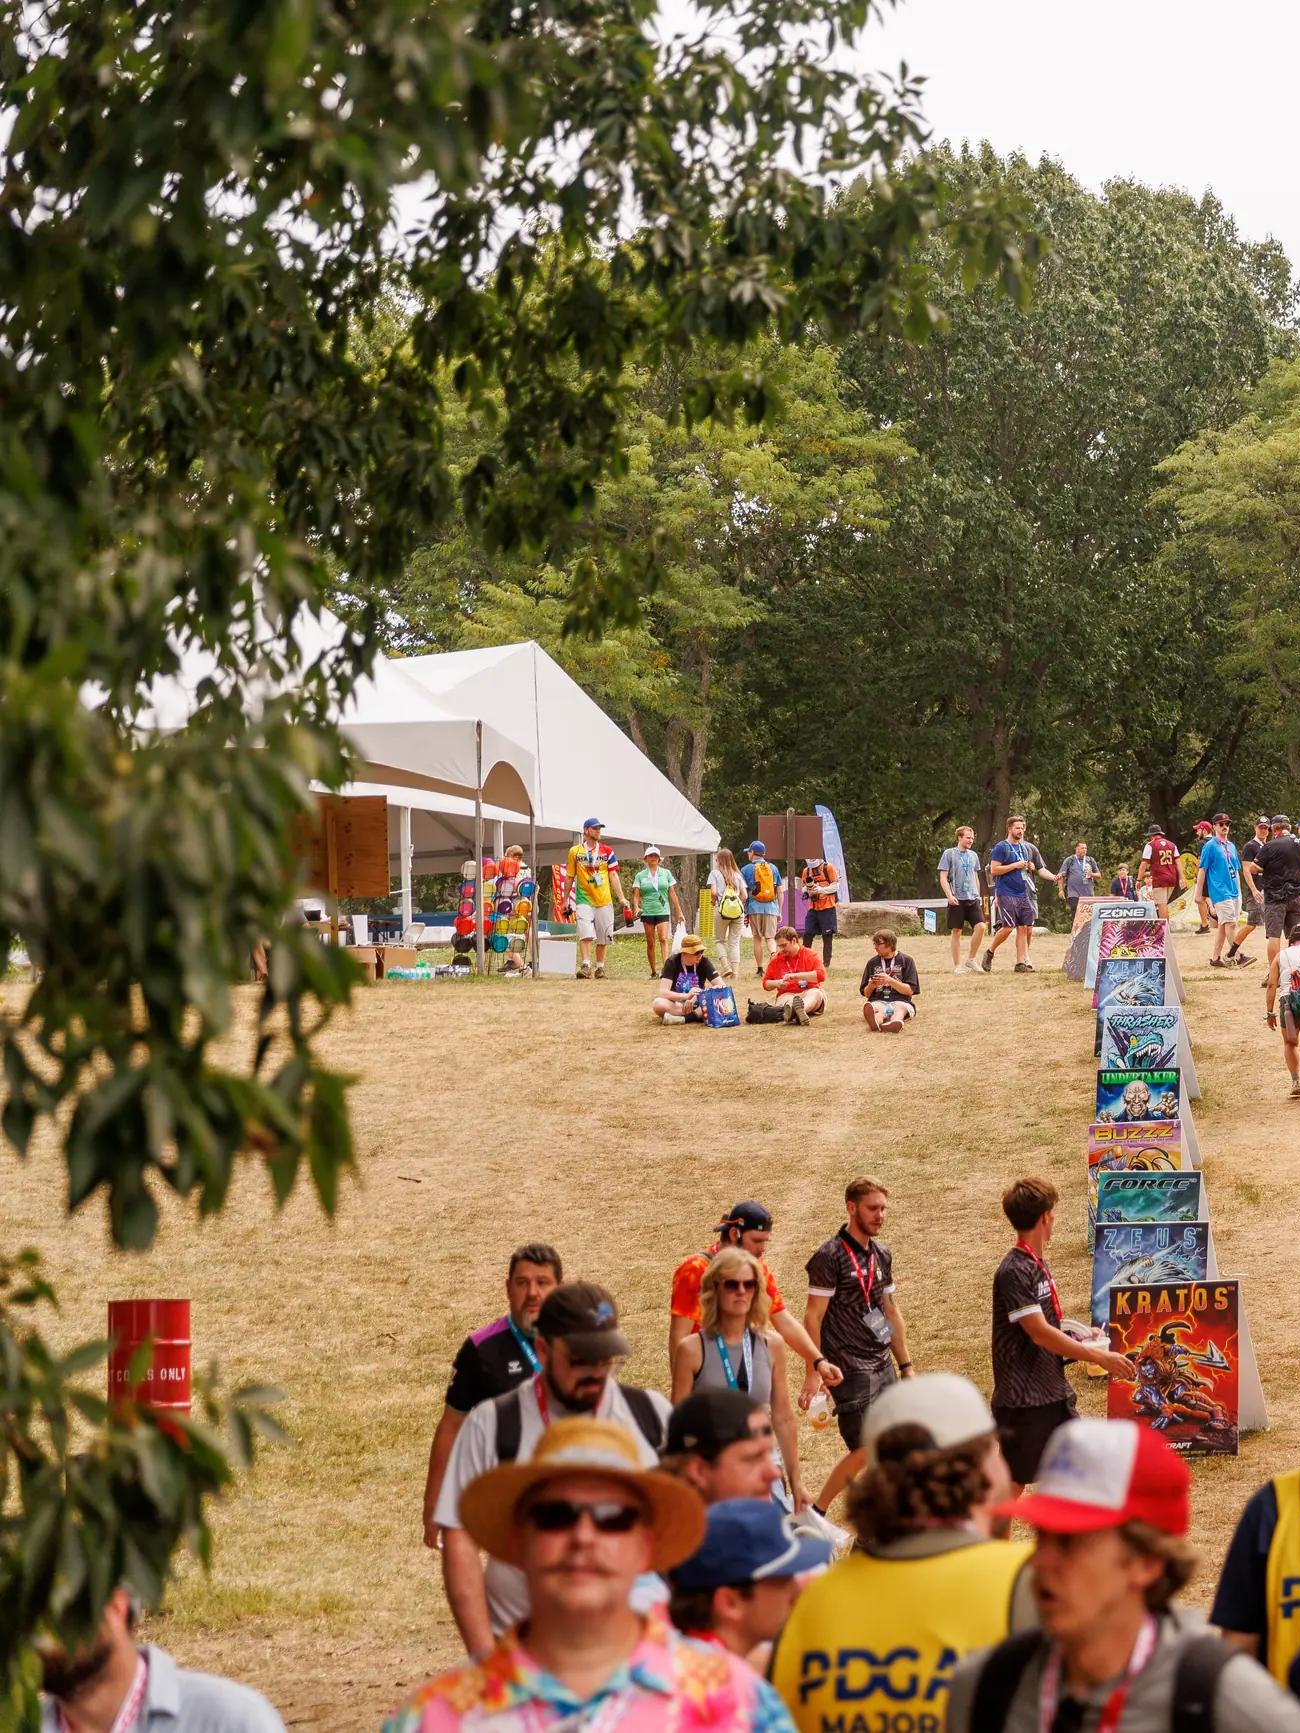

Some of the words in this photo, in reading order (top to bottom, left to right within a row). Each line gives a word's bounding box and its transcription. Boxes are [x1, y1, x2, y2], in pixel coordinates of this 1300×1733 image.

[1159, 850, 1173, 865] 25
[1099, 908, 1146, 918] ZONE
[1106, 960, 1161, 976] ZEUS
[1110, 1014, 1176, 1029] THRASHER
[1101, 1071, 1178, 1085] UNDERTAKER
[1103, 1177, 1190, 1191] FORCE
[1103, 1227, 1197, 1250] ZEUS
[1115, 1286, 1230, 1315] KRATOS
[116, 1368, 155, 1382] COS
[160, 1367, 186, 1381] ONLY
[1165, 1442, 1193, 1450] CRAFT
[798, 1647, 957, 1704] PDGA
[820, 1712, 941, 1733] MAJOR
